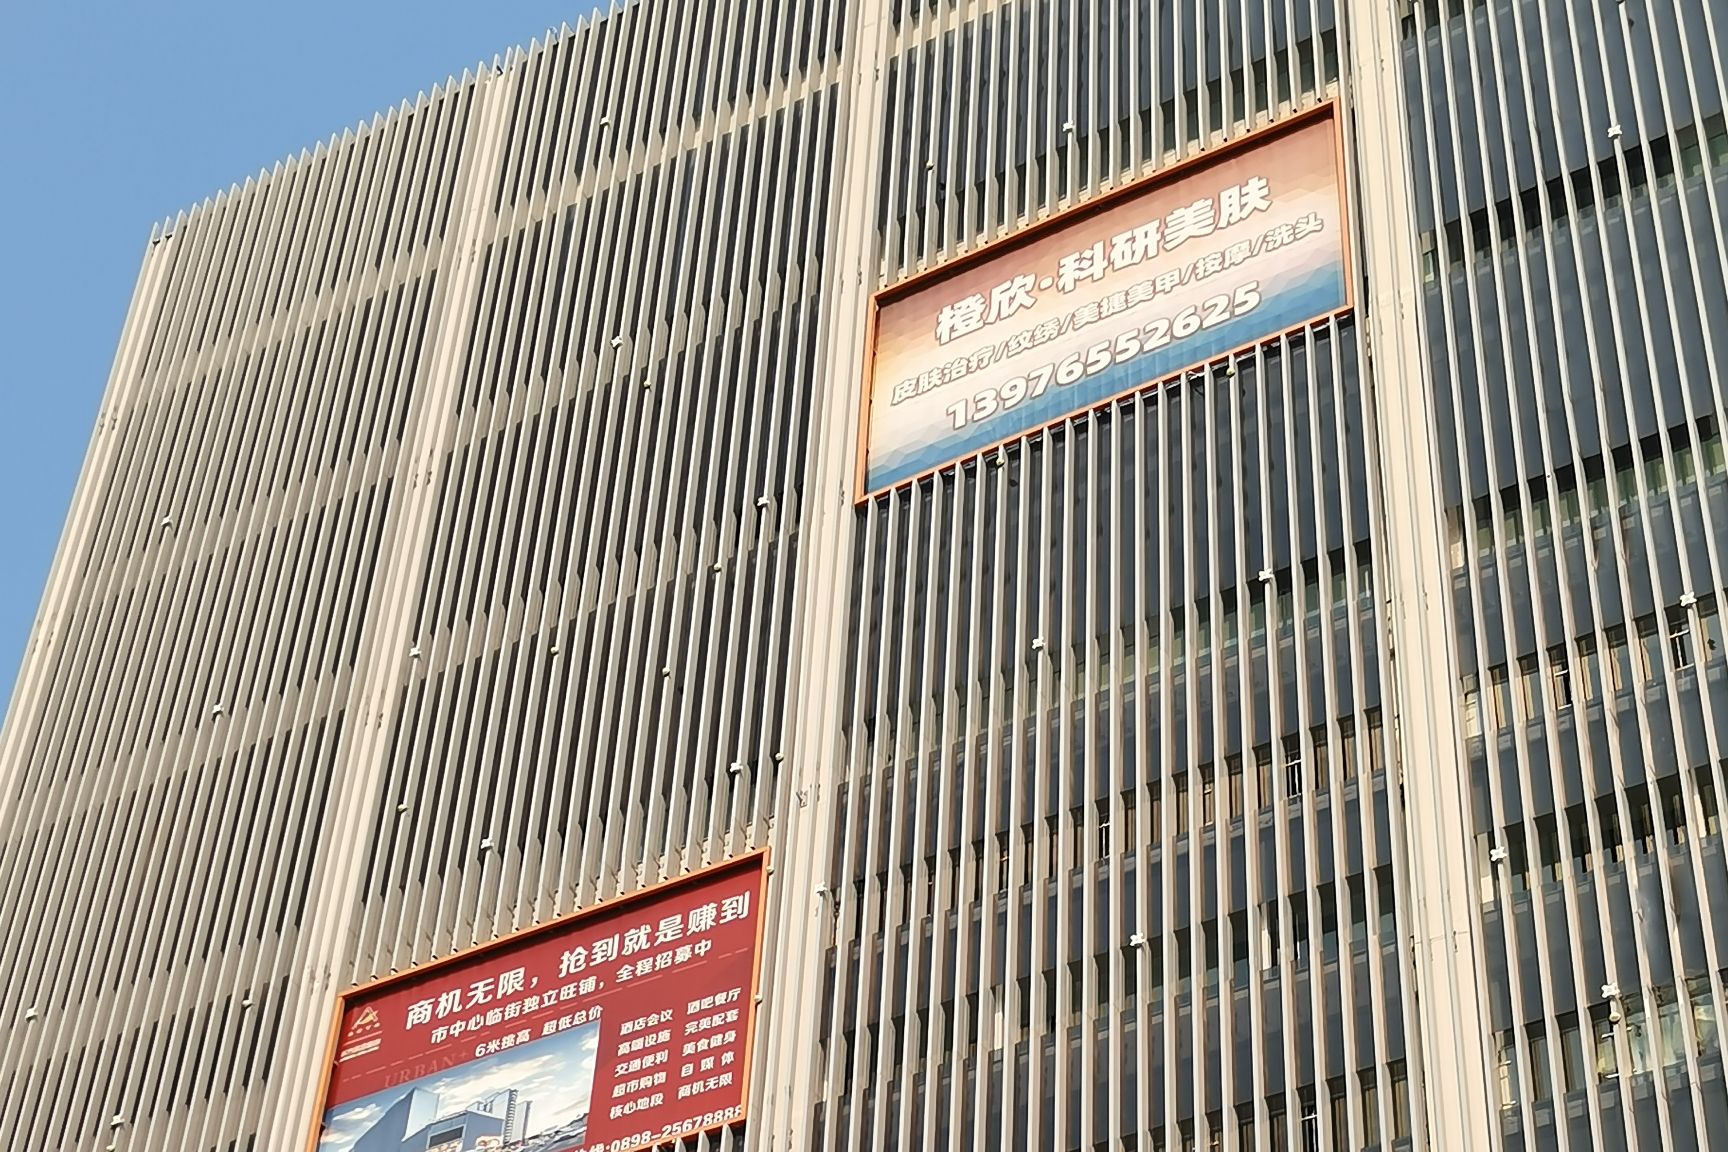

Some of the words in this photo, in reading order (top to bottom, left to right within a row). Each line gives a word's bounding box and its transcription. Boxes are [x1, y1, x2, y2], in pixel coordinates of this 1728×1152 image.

[936, 176, 1272, 345] 橙欣·科研美肤
[946, 281, 1261, 429] 13976552625
[620, 1009, 673, 1035] 酒店会议
[615, 1050, 668, 1077] 交通便利
[610, 1093, 663, 1119] 核心地段
[678, 1072, 732, 1099] 商机无限
